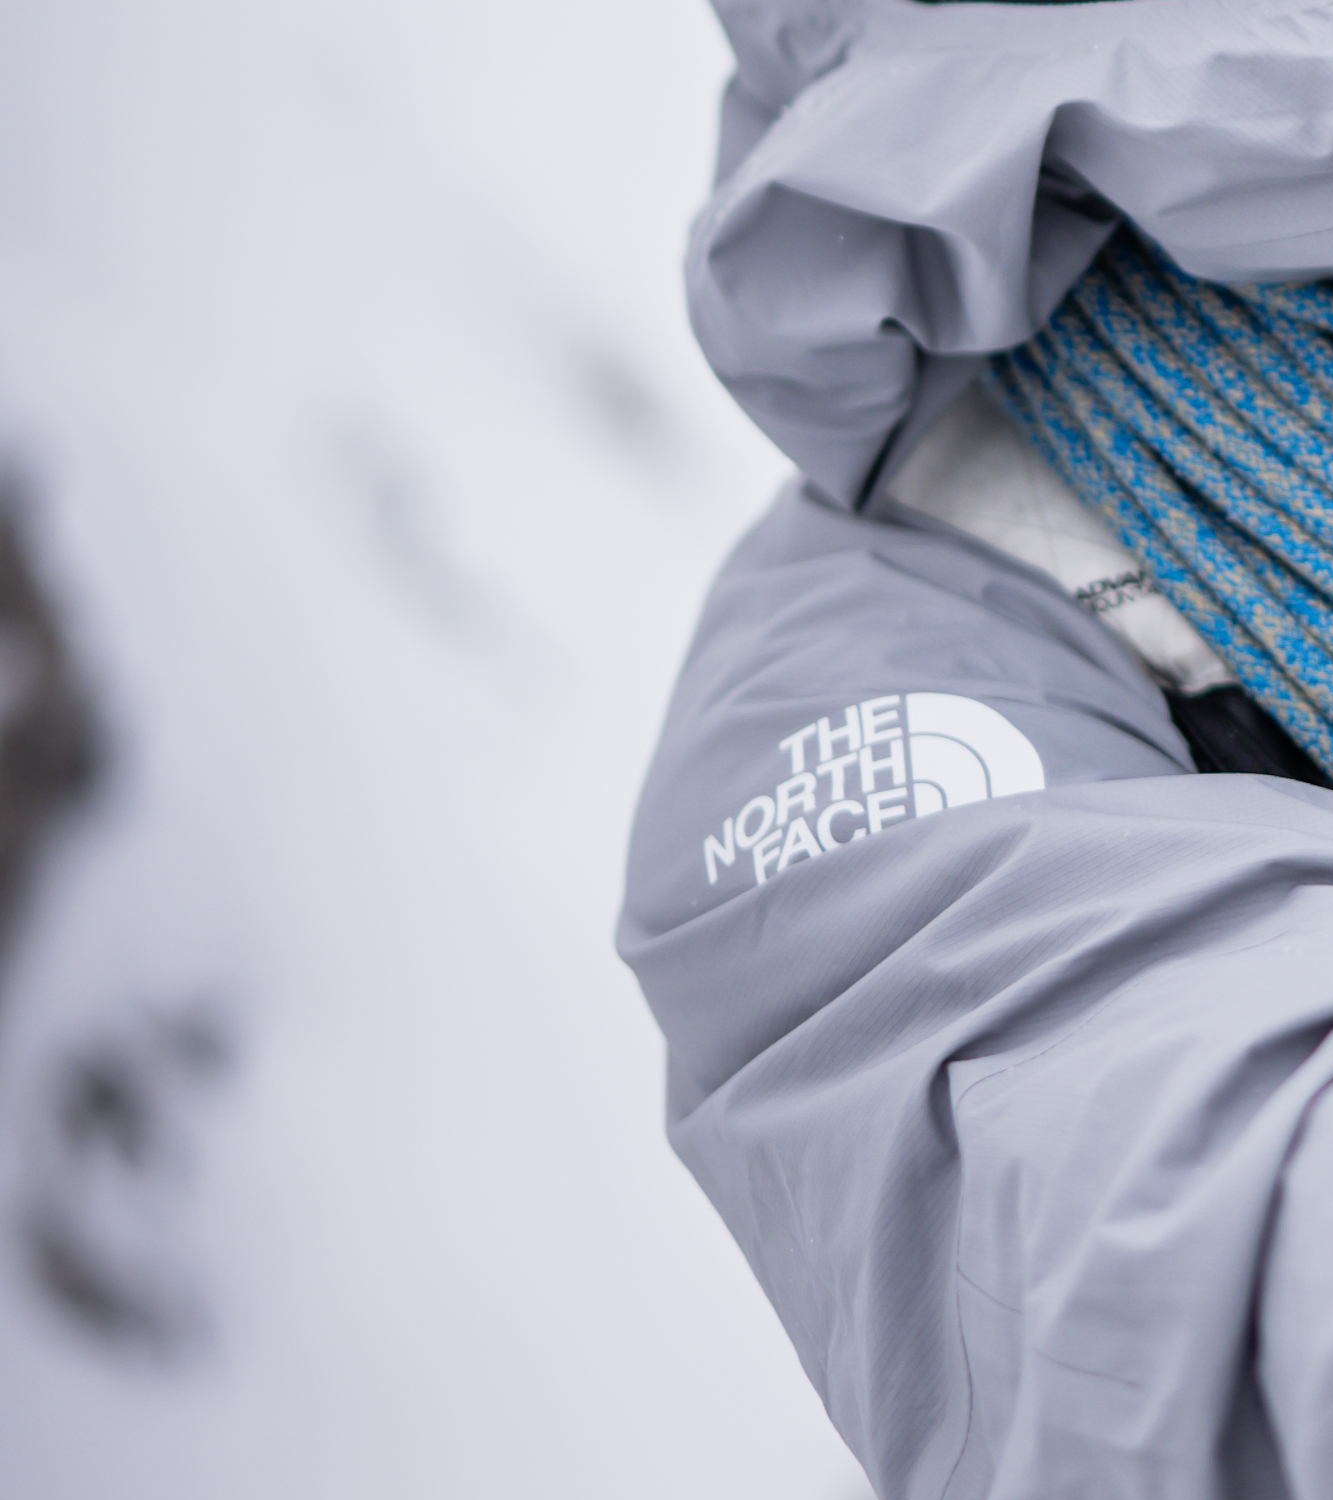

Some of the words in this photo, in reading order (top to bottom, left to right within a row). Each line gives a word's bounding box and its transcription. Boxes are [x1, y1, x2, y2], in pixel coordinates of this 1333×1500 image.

[779, 694, 903, 775] THE
[703, 738, 907, 886] NORTH
[752, 786, 908, 887] FACE
